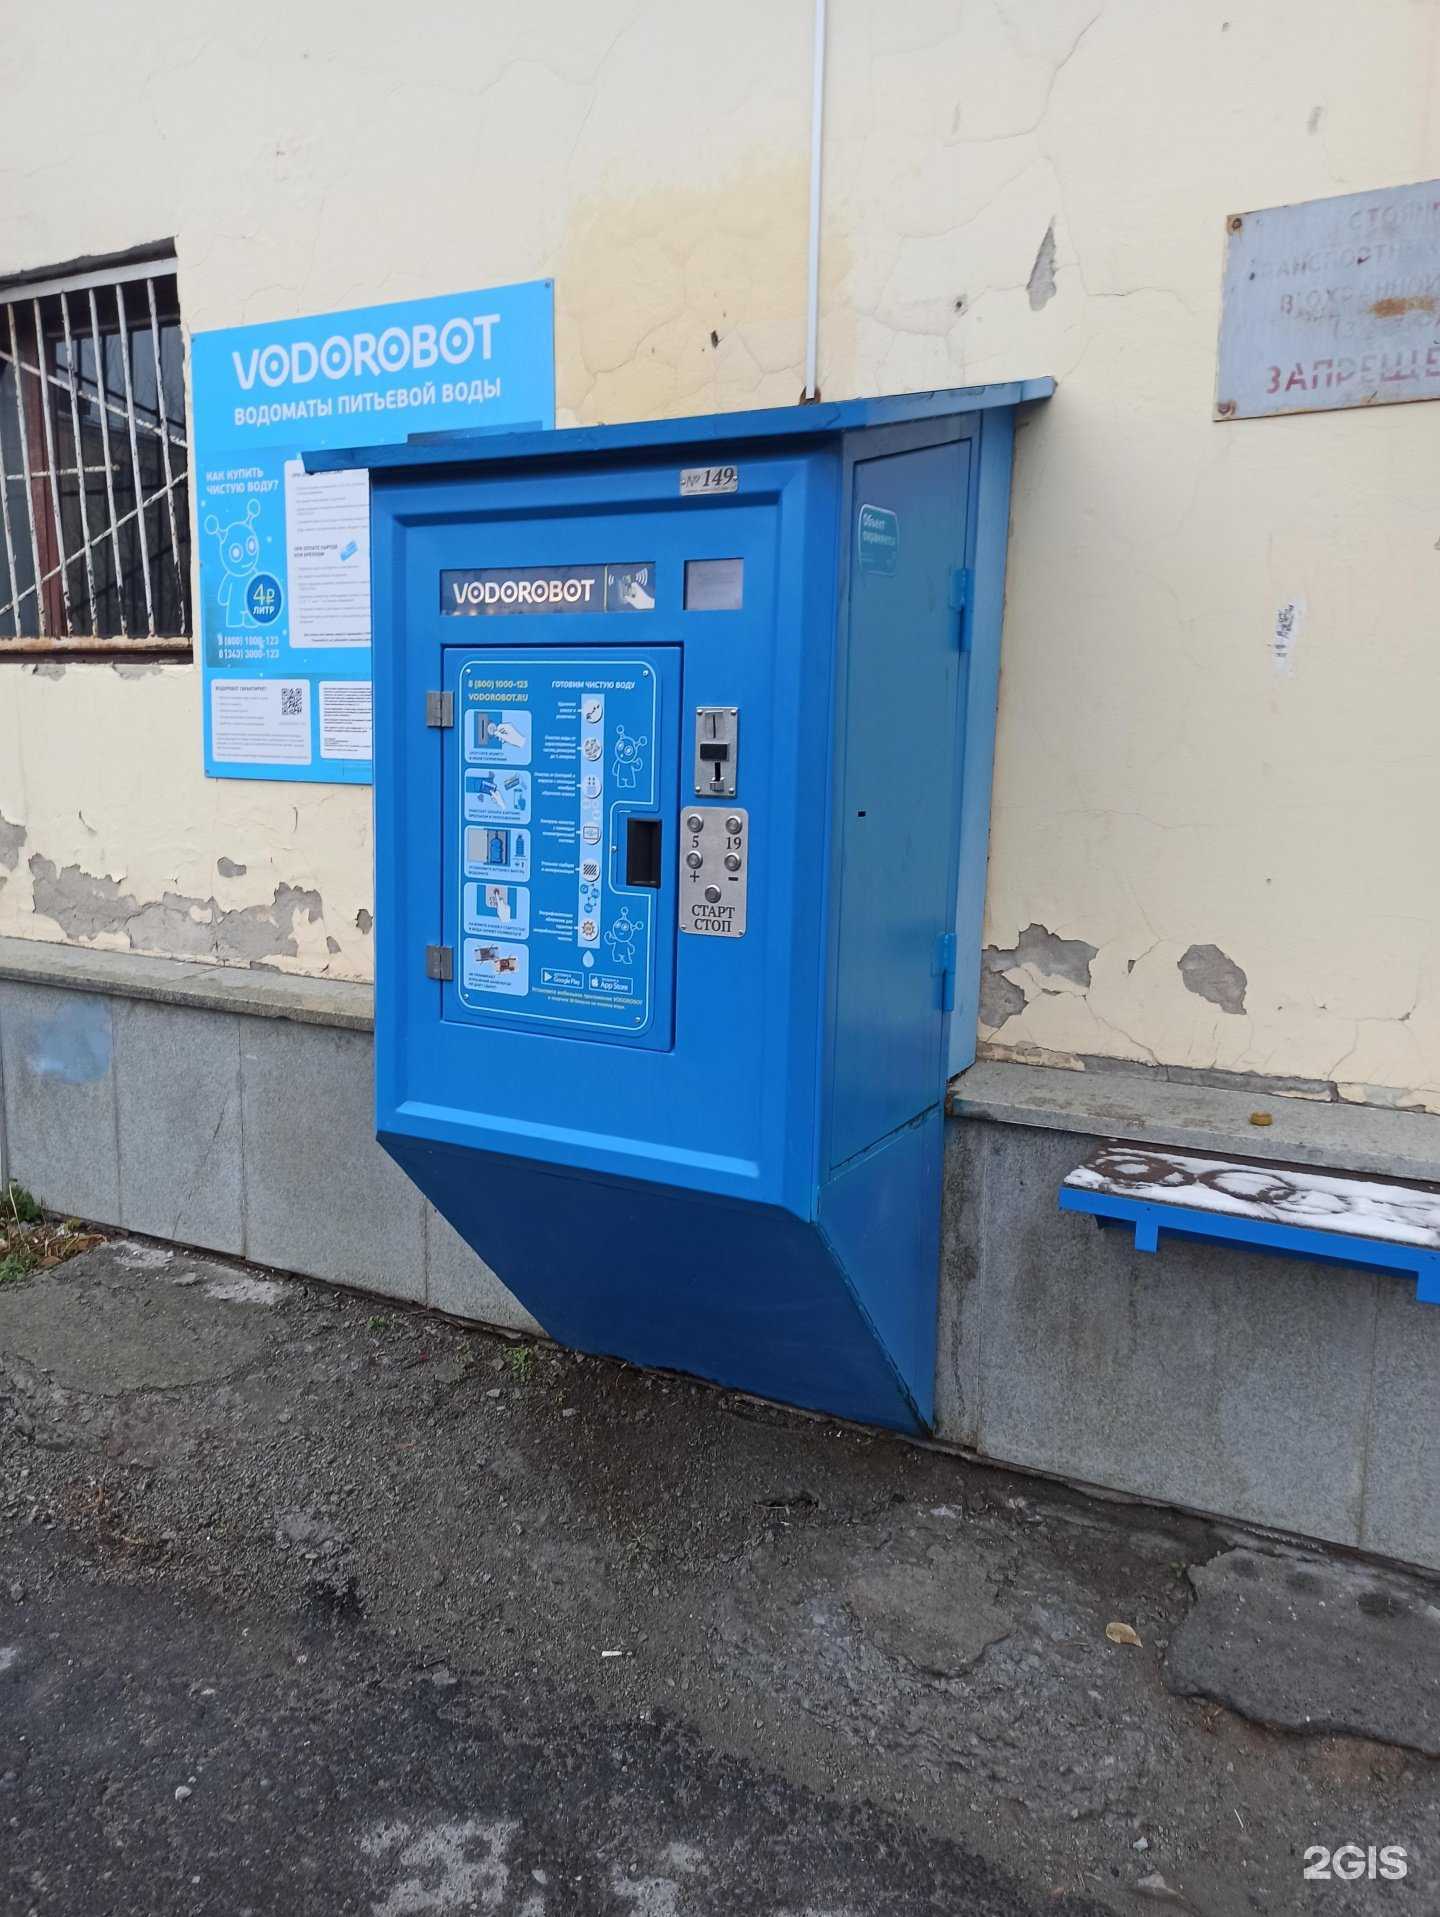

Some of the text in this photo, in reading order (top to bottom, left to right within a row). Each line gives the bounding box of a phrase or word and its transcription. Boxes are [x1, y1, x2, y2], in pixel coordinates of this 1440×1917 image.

[232, 315, 501, 390] VODOROBOT
[233, 377, 501, 427] ВОДОМАТЫ ПИТЬЕВОЙ ВОДЫ
[206, 467, 264, 482] КАК КУПИТЬ
[703, 467, 735, 487] 149
[206, 480, 280, 496] ЧИСТУЮ ВОДУ?
[453, 579, 595, 604] VODOROBOT
[253, 606, 275, 616] ЛИТР
[474, 680, 494, 689] (800)
[495, 680, 529, 689] 1000-123
[551, 680, 636, 690] ГОТОВИМ ЧИСТУЮ ВОДУ
[468, 693, 529, 702] VODOROBOT.RU
[691, 835, 742, 850] 5 19
[691, 904, 736, 919] СТАРТ
[693, 918, 732, 933] СТОП
[553, 974, 571, 984] Google
[570, 977, 580, 986] Play
[600, 982, 629, 991] App Store
